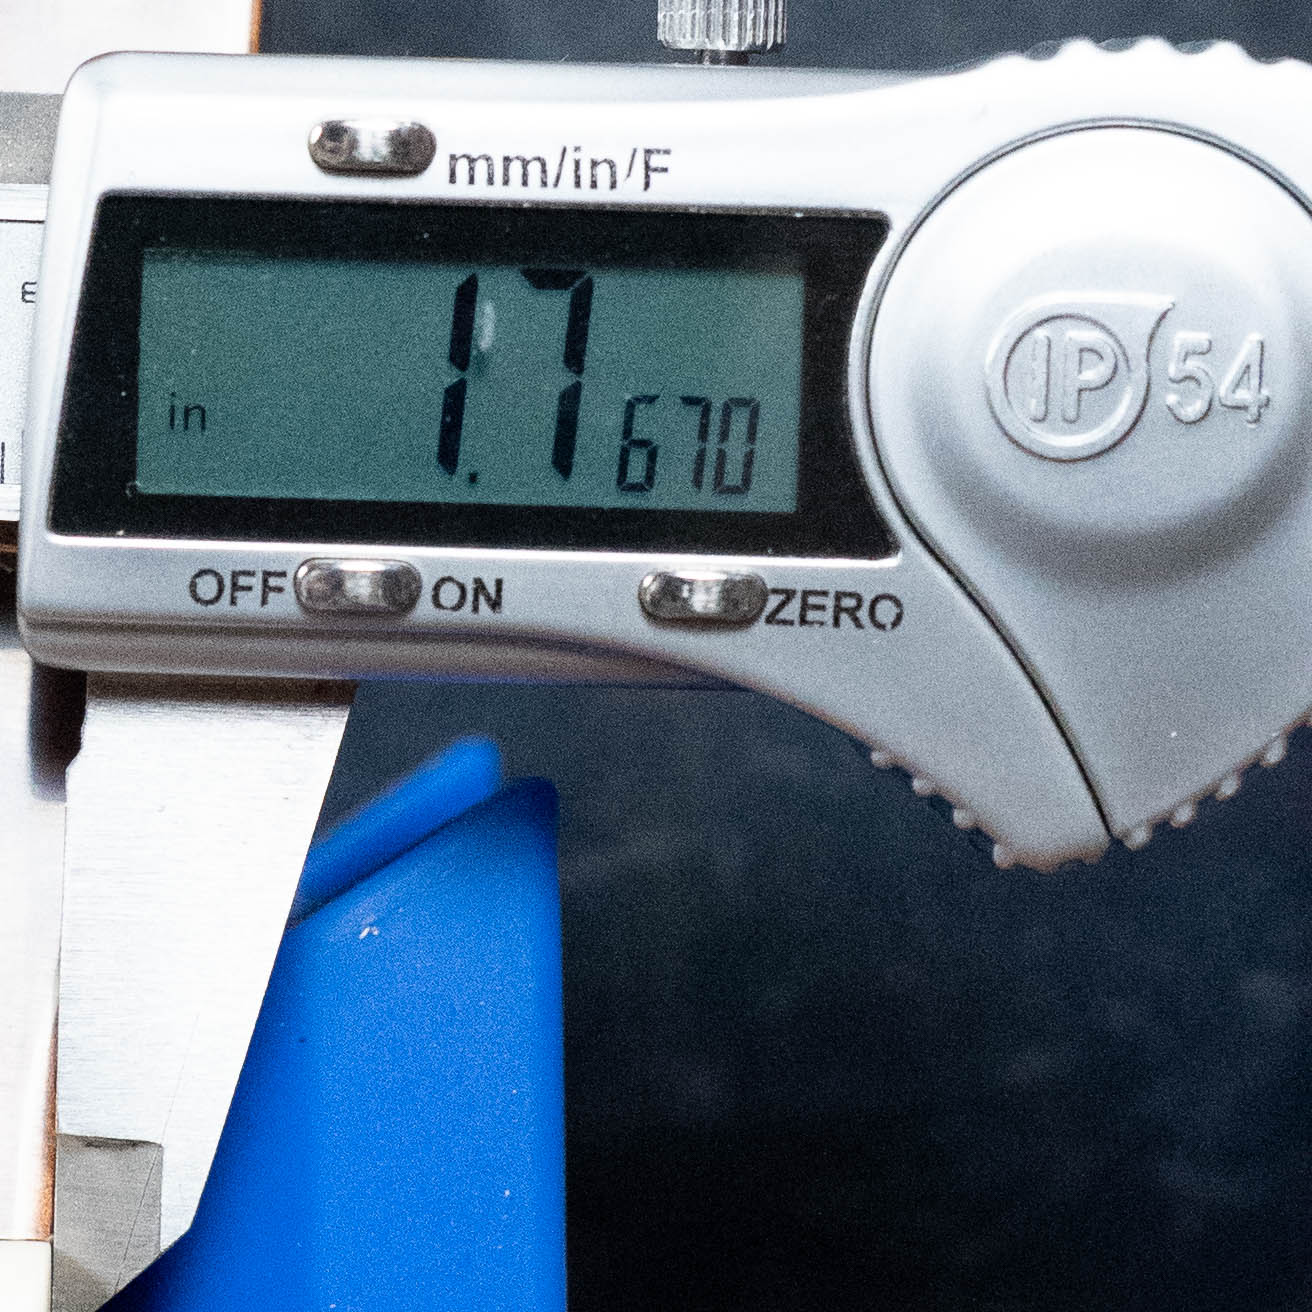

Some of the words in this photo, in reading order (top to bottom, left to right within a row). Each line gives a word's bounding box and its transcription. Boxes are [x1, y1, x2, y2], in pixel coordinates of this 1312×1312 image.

[447, 146, 673, 194] mm/in/F
[1026, 329, 1121, 424] IP
[1164, 330, 1272, 429] 54
[168, 393, 208, 433] in
[188, 567, 289, 609] OFF
[430, 575, 504, 615] ON
[764, 586, 904, 631] ZERO
